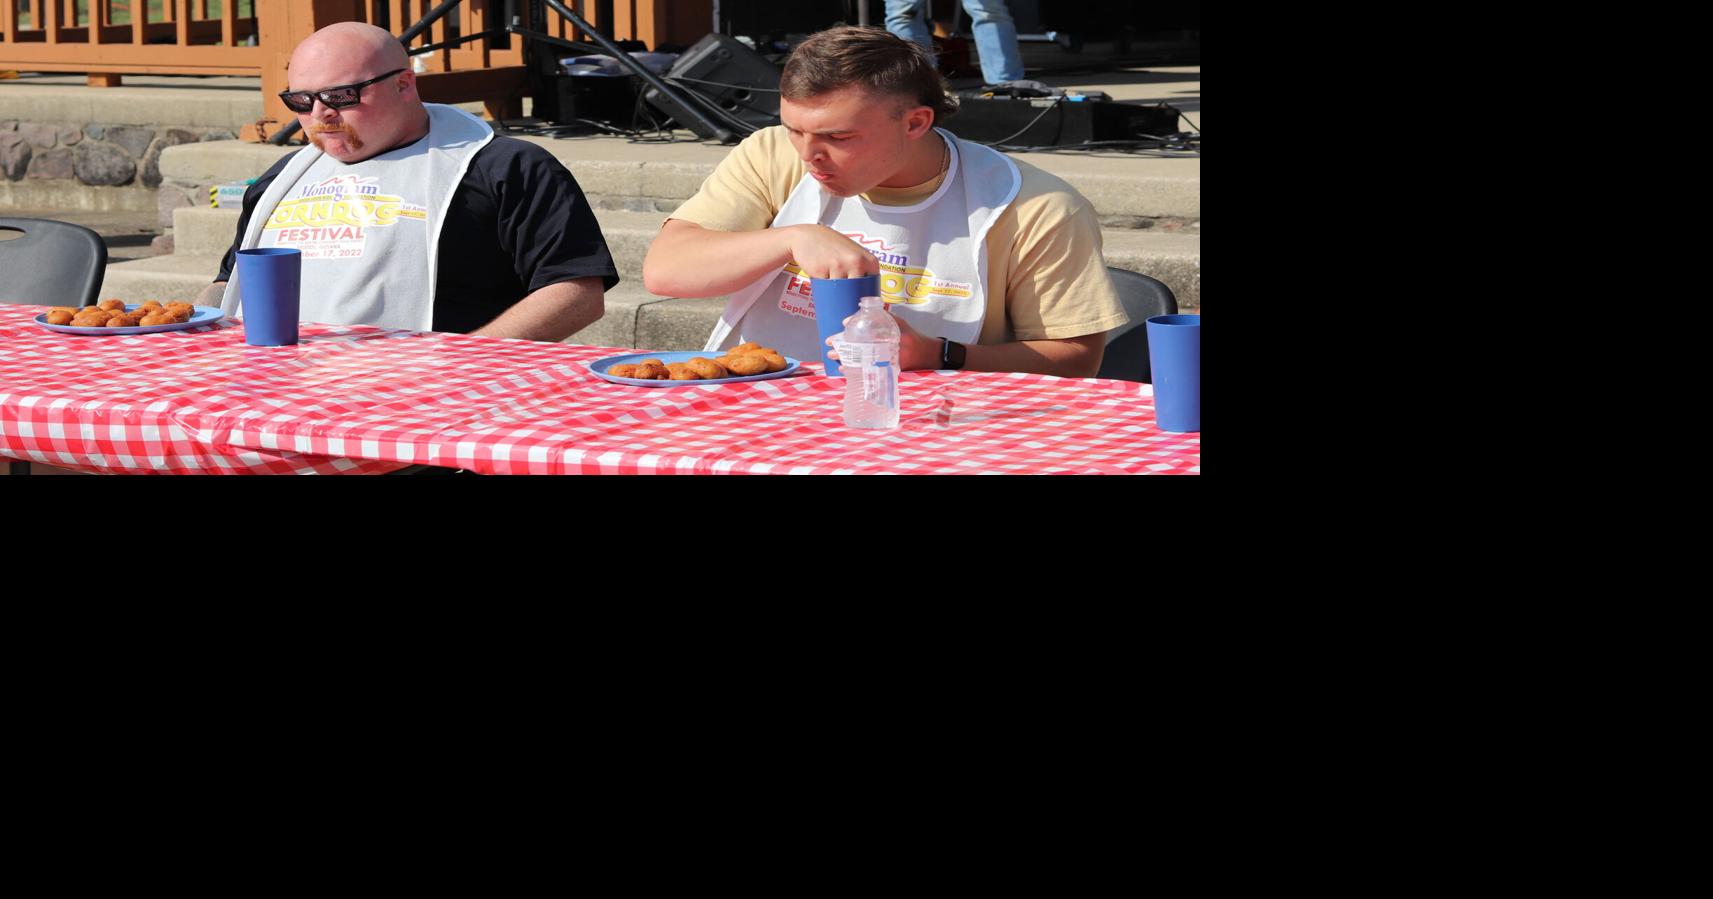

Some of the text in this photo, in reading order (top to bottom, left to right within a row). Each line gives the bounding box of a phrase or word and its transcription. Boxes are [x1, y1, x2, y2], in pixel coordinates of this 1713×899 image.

[278, 227, 364, 242] FESTIVAL
[338, 249, 362, 257] 2022
[787, 276, 812, 297] FE
